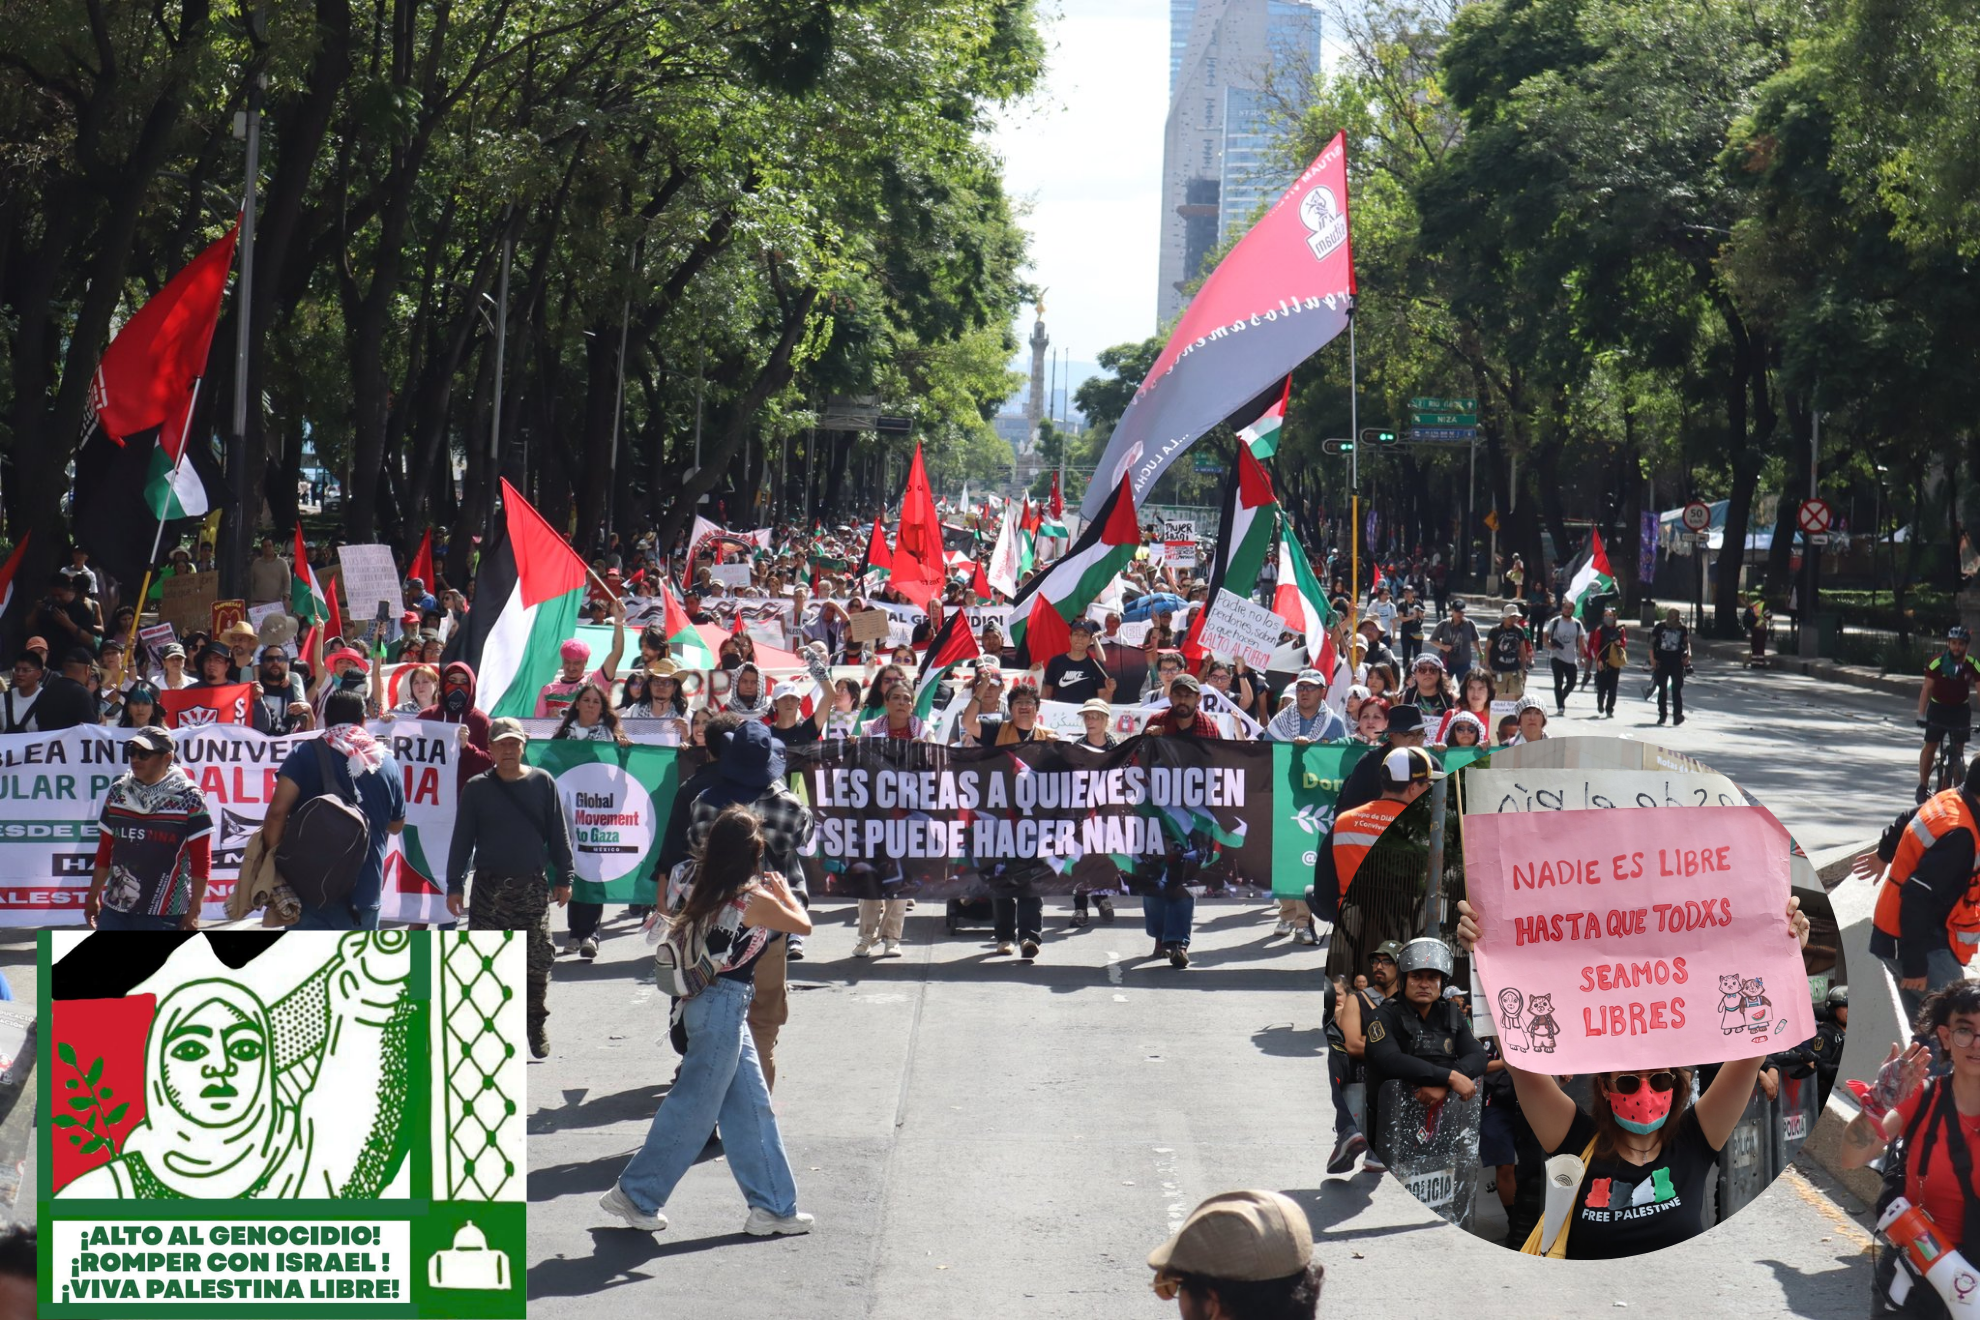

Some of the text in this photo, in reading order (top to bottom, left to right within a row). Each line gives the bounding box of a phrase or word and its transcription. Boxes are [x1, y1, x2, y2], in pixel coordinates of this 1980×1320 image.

[1690, 509, 1703, 518] 50
[1249, 610, 1262, 622] no
[1063, 670, 1085, 679] NIKE
[575, 792, 614, 810] Global
[815, 768, 868, 808] LES
[876, 769, 980, 810] CREAS
[987, 771, 1008, 809] A
[1015, 766, 1148, 817] QUIENES
[1150, 767, 1245, 808] DICEN
[575, 810, 640, 827] Movement
[576, 828, 620, 844] to Gaza
[823, 818, 858, 858] SE
[865, 819, 965, 858] PUEDE
[973, 818, 1076, 860] HACER
[1082, 815, 1165, 857] NADA
[1512, 846, 1732, 891] NADIE ES LIBRE
[1514, 897, 1733, 946] HASTA QUE TODXS
[1579, 956, 1689, 993] SEAMOS
[1583, 998, 1686, 1037] LIBRES
[1582, 1196, 1682, 1223] FREE PALESTINE
